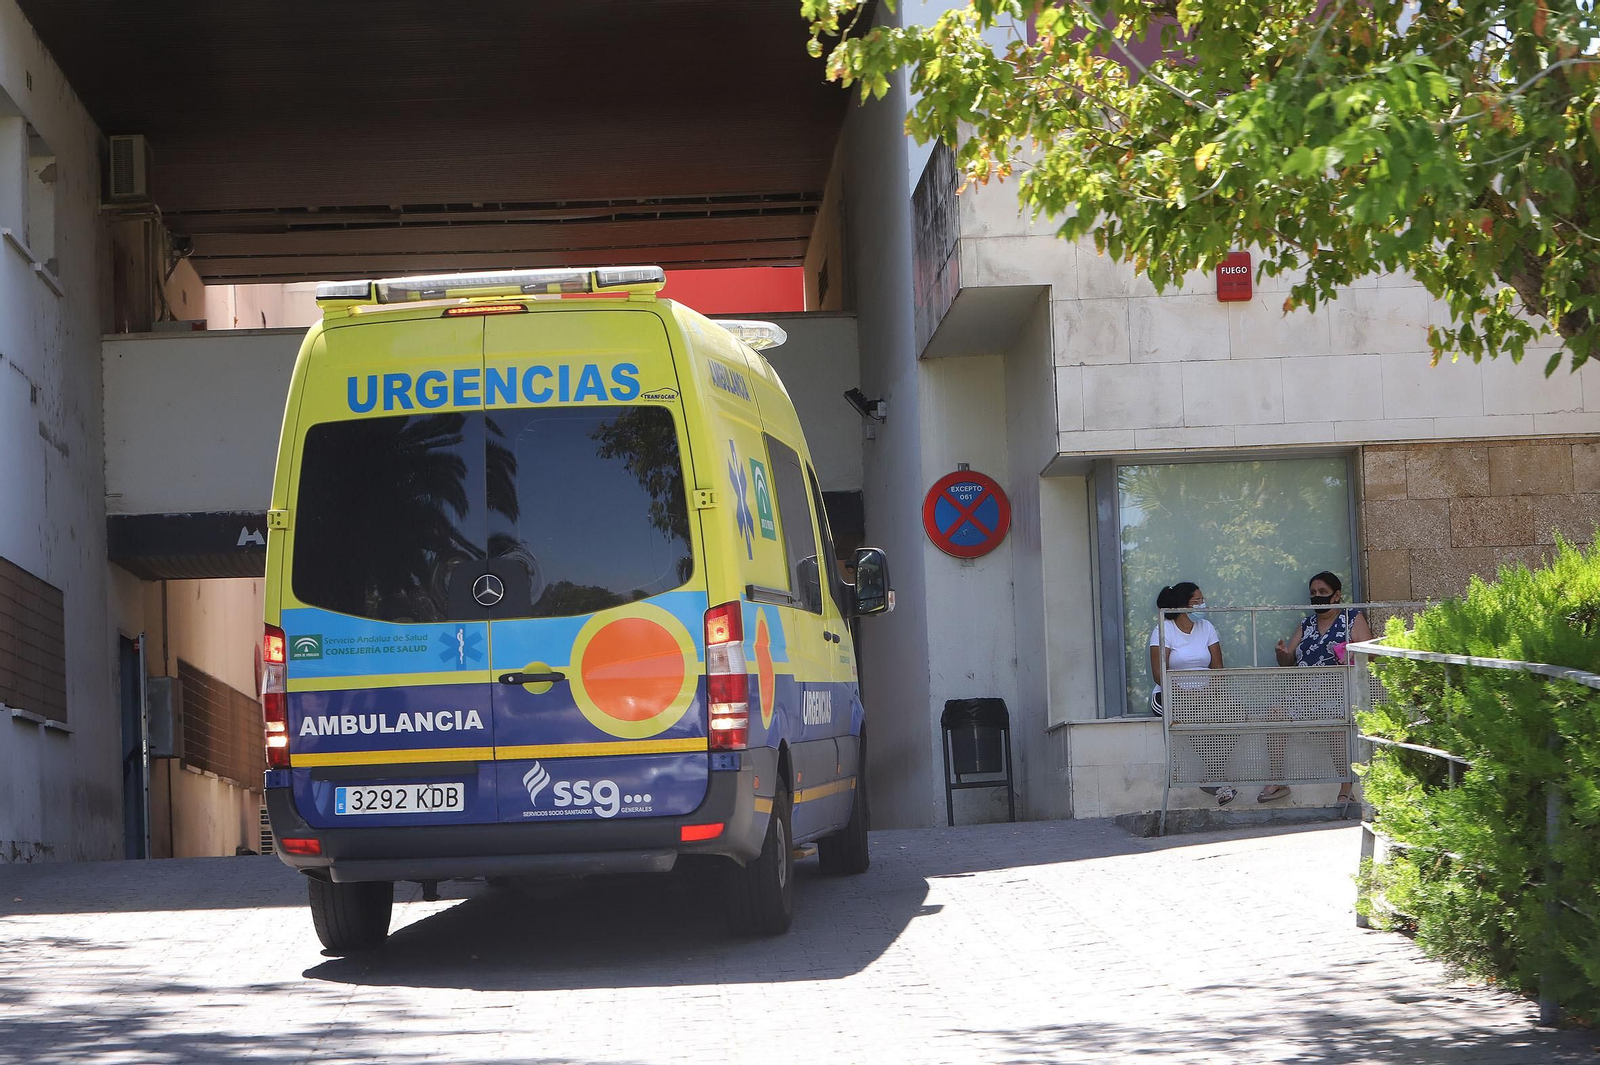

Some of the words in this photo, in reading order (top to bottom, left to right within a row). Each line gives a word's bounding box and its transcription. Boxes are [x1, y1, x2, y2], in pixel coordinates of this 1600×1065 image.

[1221, 266, 1248, 275] FUEGO
[347, 362, 641, 413] URGENCIAS
[950, 485, 983, 493] EXCEPTO
[324, 635, 356, 645] Servicio
[357, 633, 391, 643] Andaluz
[392, 634, 404, 642] de
[405, 633, 428, 642] Salud
[397, 644, 428, 653] SALUD
[299, 709, 484, 737] AMBULANCIA
[351, 789, 408, 811] 3292
[416, 786, 459, 809] KDB
[564, 808, 593, 816] SANITARIOS
